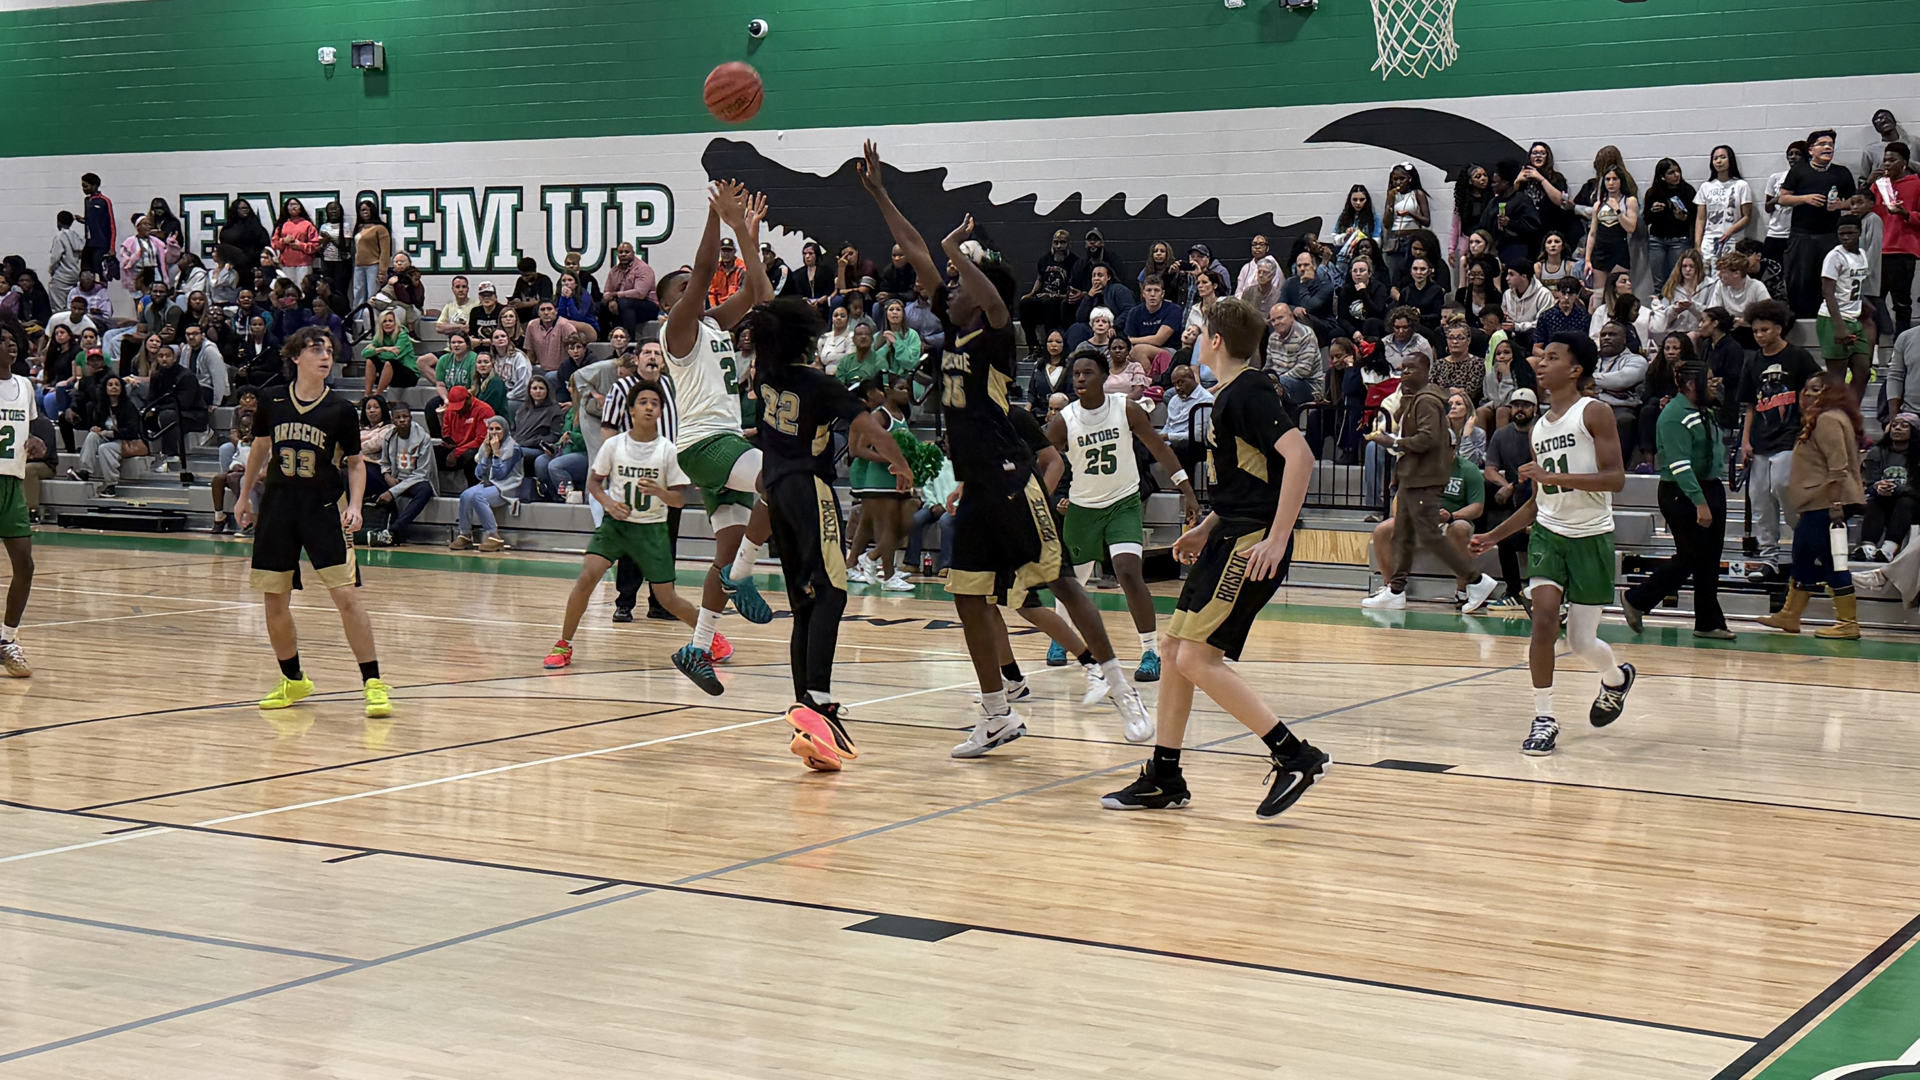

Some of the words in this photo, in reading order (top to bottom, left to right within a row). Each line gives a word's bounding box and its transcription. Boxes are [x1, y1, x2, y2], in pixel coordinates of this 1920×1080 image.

[541, 182, 676, 273] UP
[719, 356, 739, 395] 2
[0, 408, 26, 422] TORS
[760, 383, 800, 436] 22
[274, 422, 327, 450] BRISCOE
[1077, 427, 1120, 447] GATORS
[1535, 433, 1576, 454] GATORS
[280, 446, 317, 478] 33
[618, 465, 660, 479] GATORS
[1084, 443, 1118, 476] 25
[623, 481, 653, 512] 10
